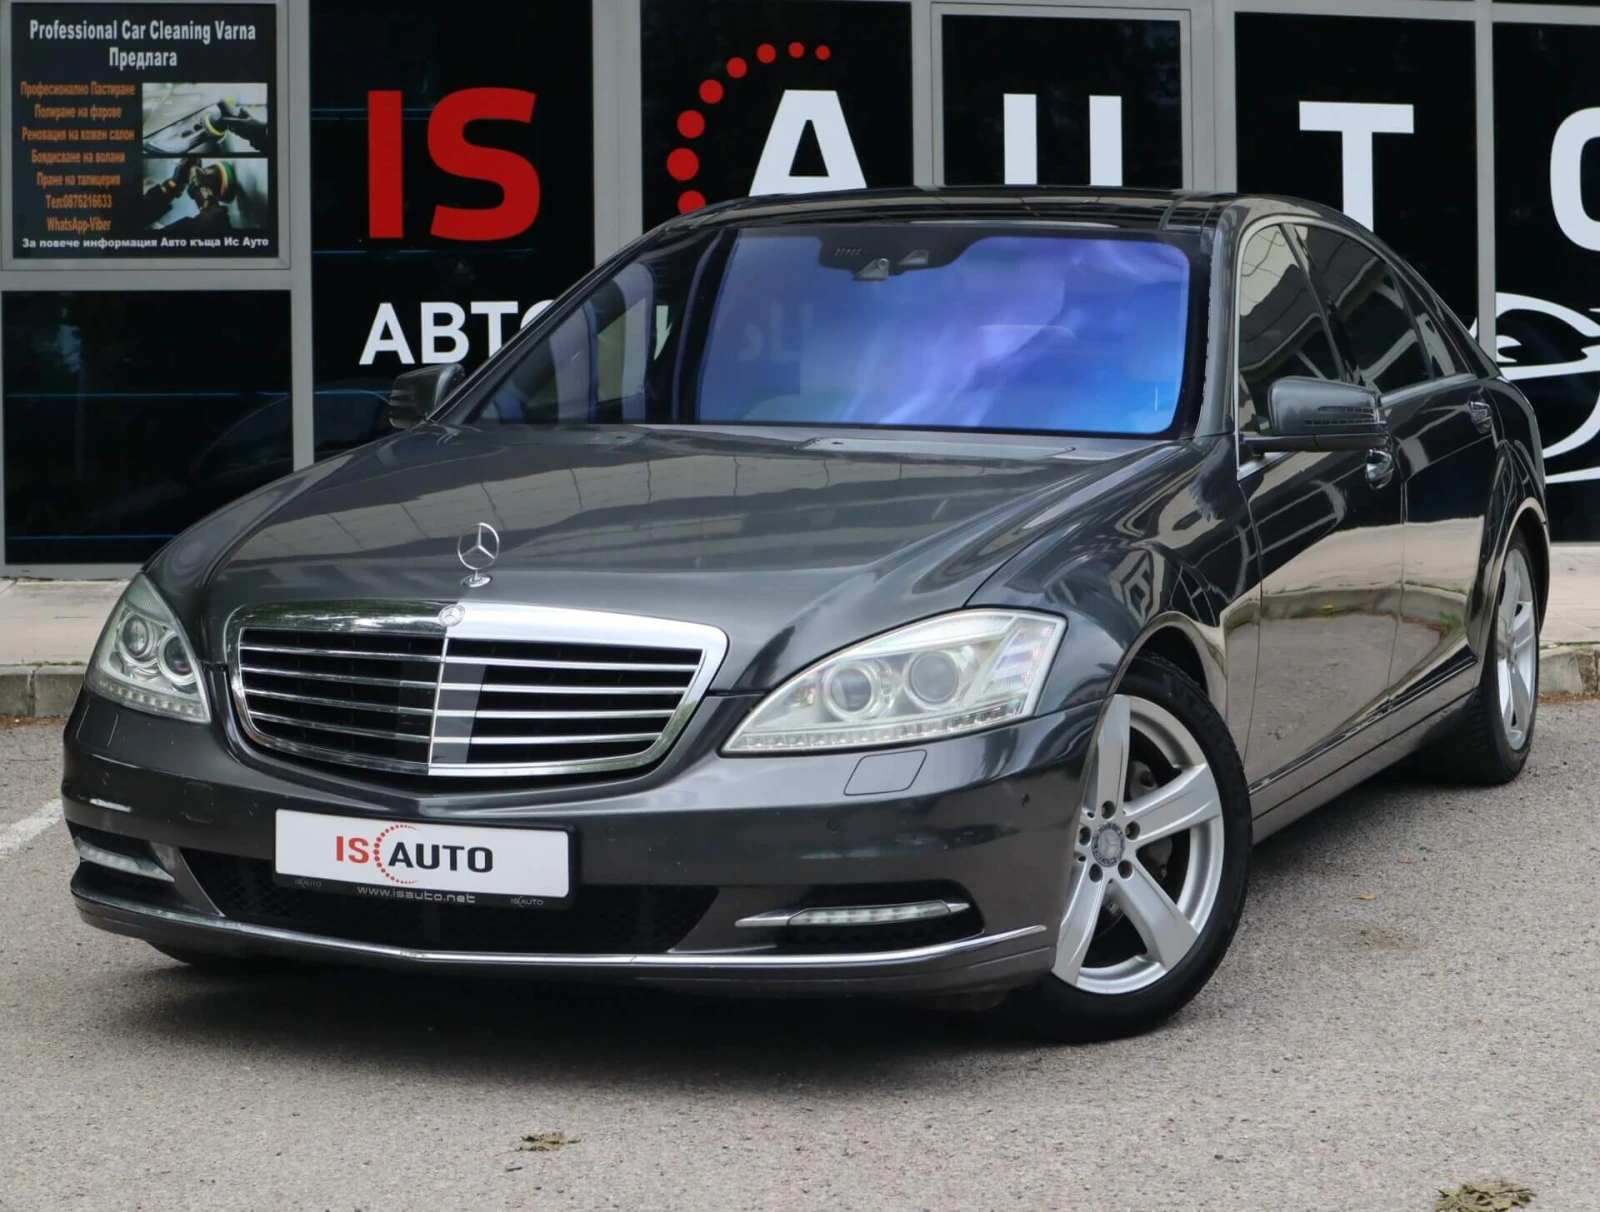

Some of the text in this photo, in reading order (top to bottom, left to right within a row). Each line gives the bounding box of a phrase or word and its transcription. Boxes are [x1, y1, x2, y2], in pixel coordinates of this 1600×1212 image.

[29, 19, 256, 45] Professional Car Cleaning Varna
[109, 46, 178, 71] Предлага
[20, 80, 89, 98] Професионално
[77, 107, 88, 119] на
[90, 103, 122, 121] фарове
[21, 126, 135, 143] Реновация на кожен салон
[82, 152, 93, 164] на
[95, 152, 126, 164] волани
[368, 88, 540, 240] IS
[36, 171, 121, 189] Пране на тапицерия
[21, 237, 270, 251] За повече информация Авто къща Ис Ауто
[358, 300, 556, 369] АВТ
[335, 836, 494, 874] IS AUTO
[356, 885, 477, 905] www.isauto.net
